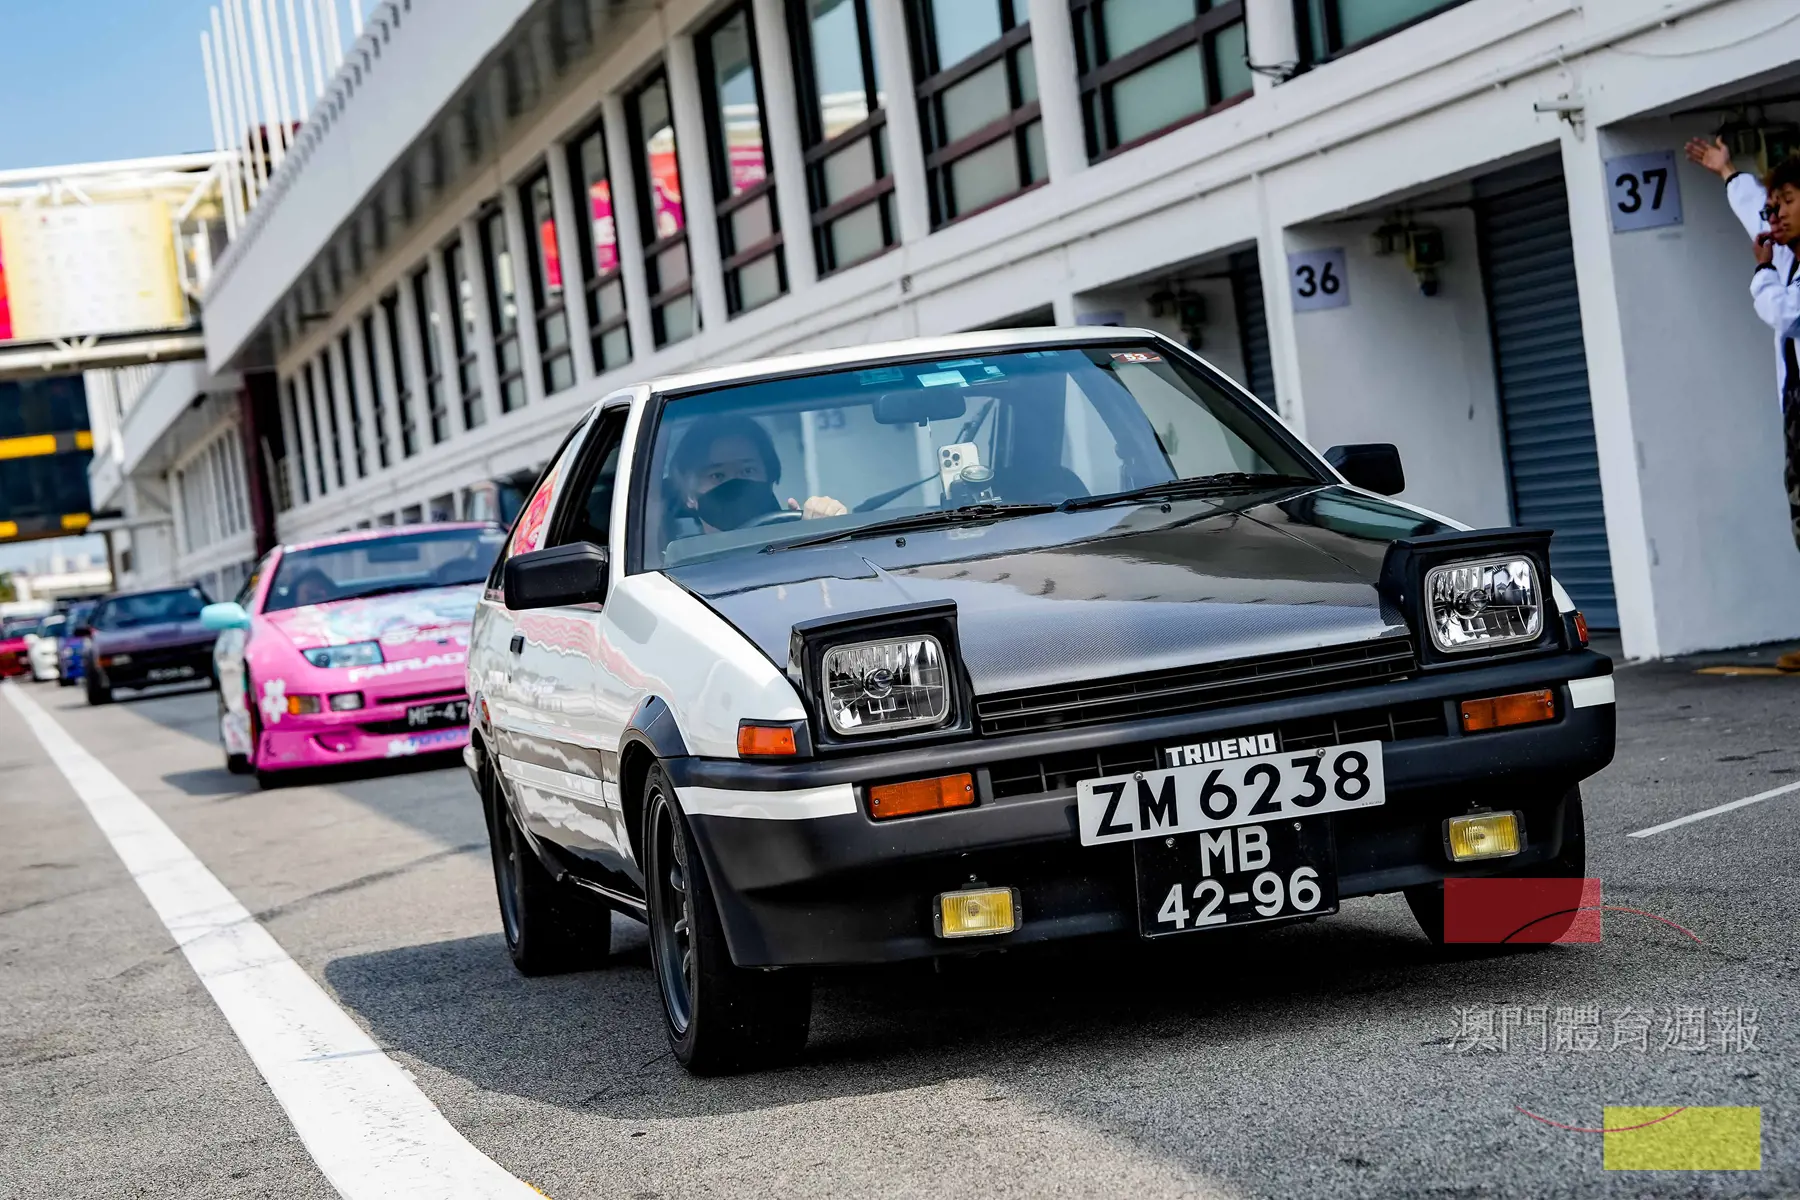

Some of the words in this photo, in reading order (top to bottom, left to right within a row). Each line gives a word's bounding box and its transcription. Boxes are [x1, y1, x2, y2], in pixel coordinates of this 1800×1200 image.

[1614, 167, 1668, 214] 37
[1295, 261, 1341, 298] 36
[1165, 733, 1277, 767] TRUENO
[1092, 775, 1180, 837] ZM
[1200, 751, 1371, 821] 6238
[1200, 825, 1271, 877] MB
[1157, 866, 1322, 929] 42-96
